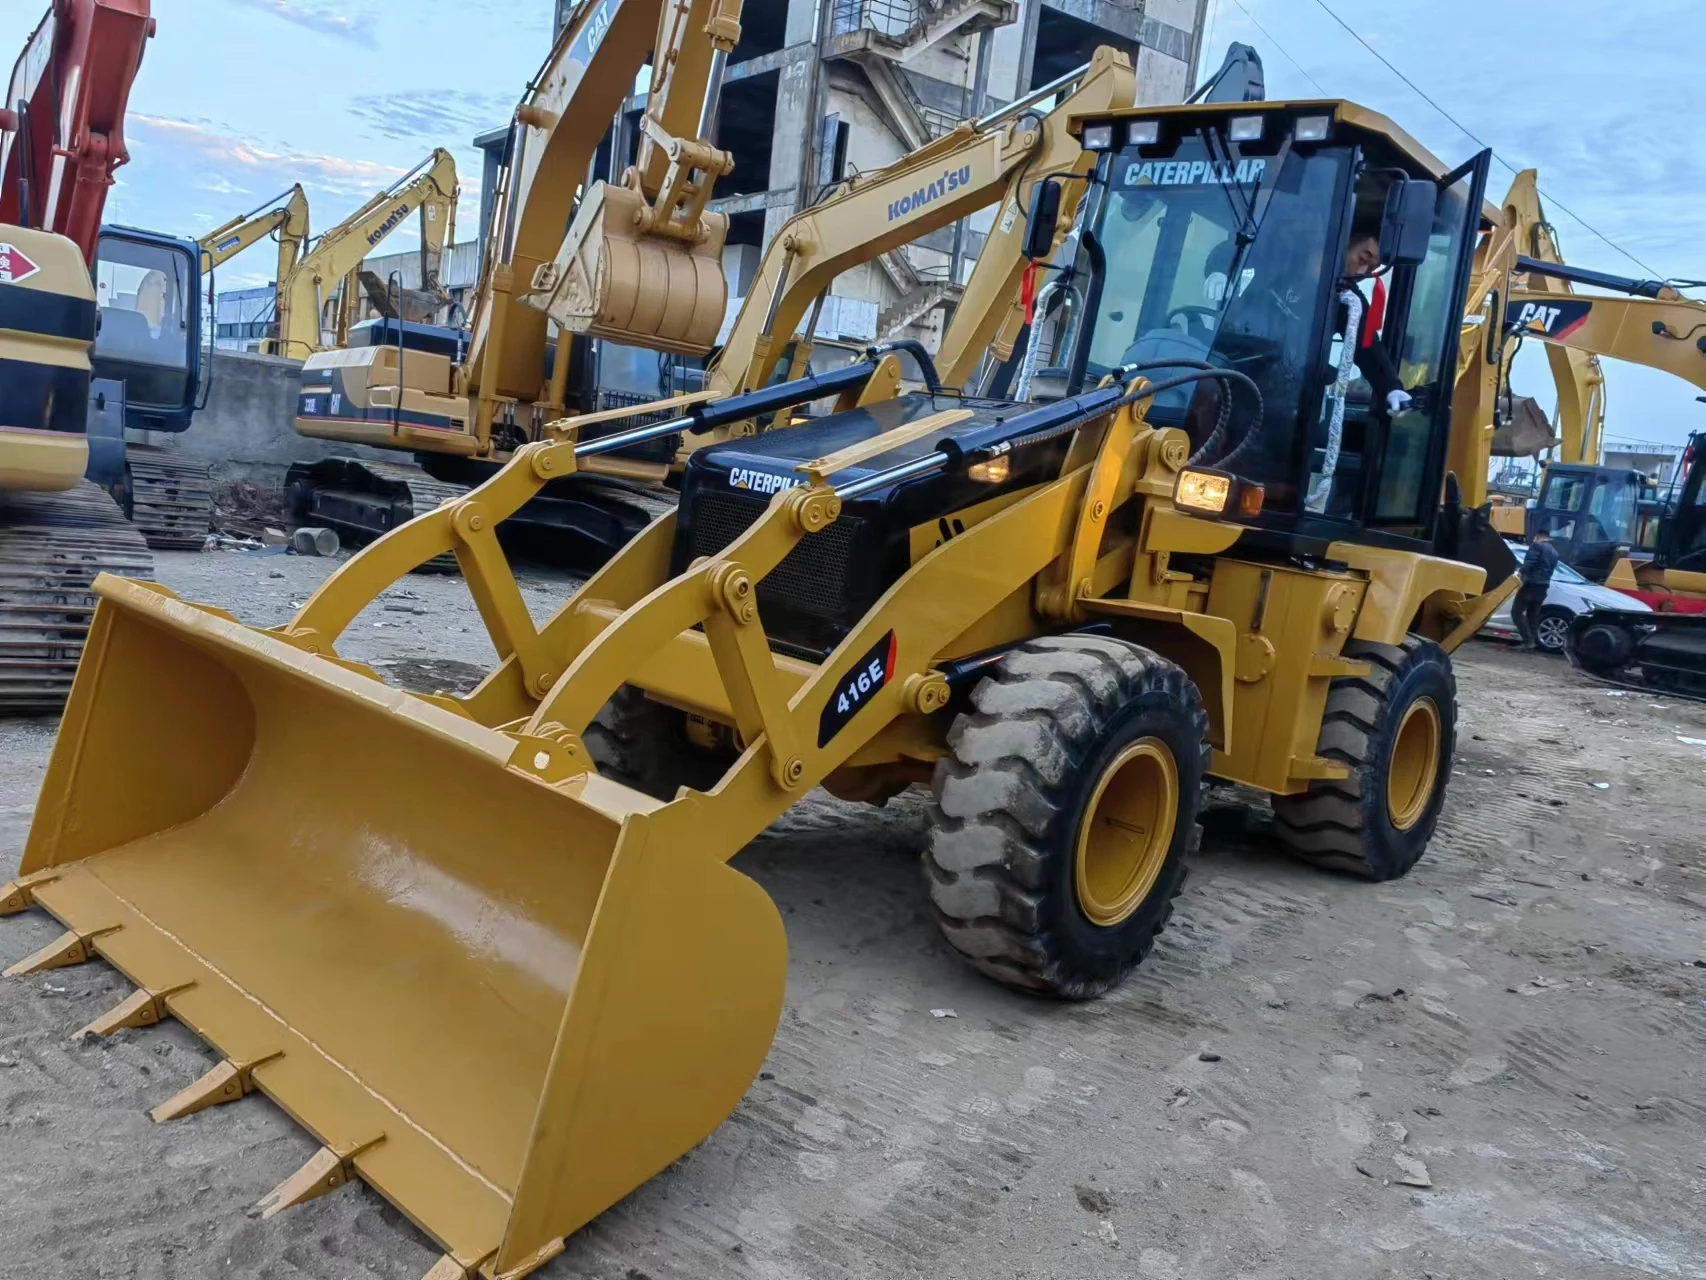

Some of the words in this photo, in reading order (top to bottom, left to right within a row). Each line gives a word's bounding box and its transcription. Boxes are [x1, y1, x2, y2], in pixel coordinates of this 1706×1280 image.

[588, 0, 608, 53] CAT
[888, 165, 970, 222] KOMATSU
[1124, 159, 1266, 186] CATERPILLAR
[367, 204, 409, 245] KOMATSU
[1519, 302, 1561, 333] CAT
[837, 658, 884, 714] 416E
